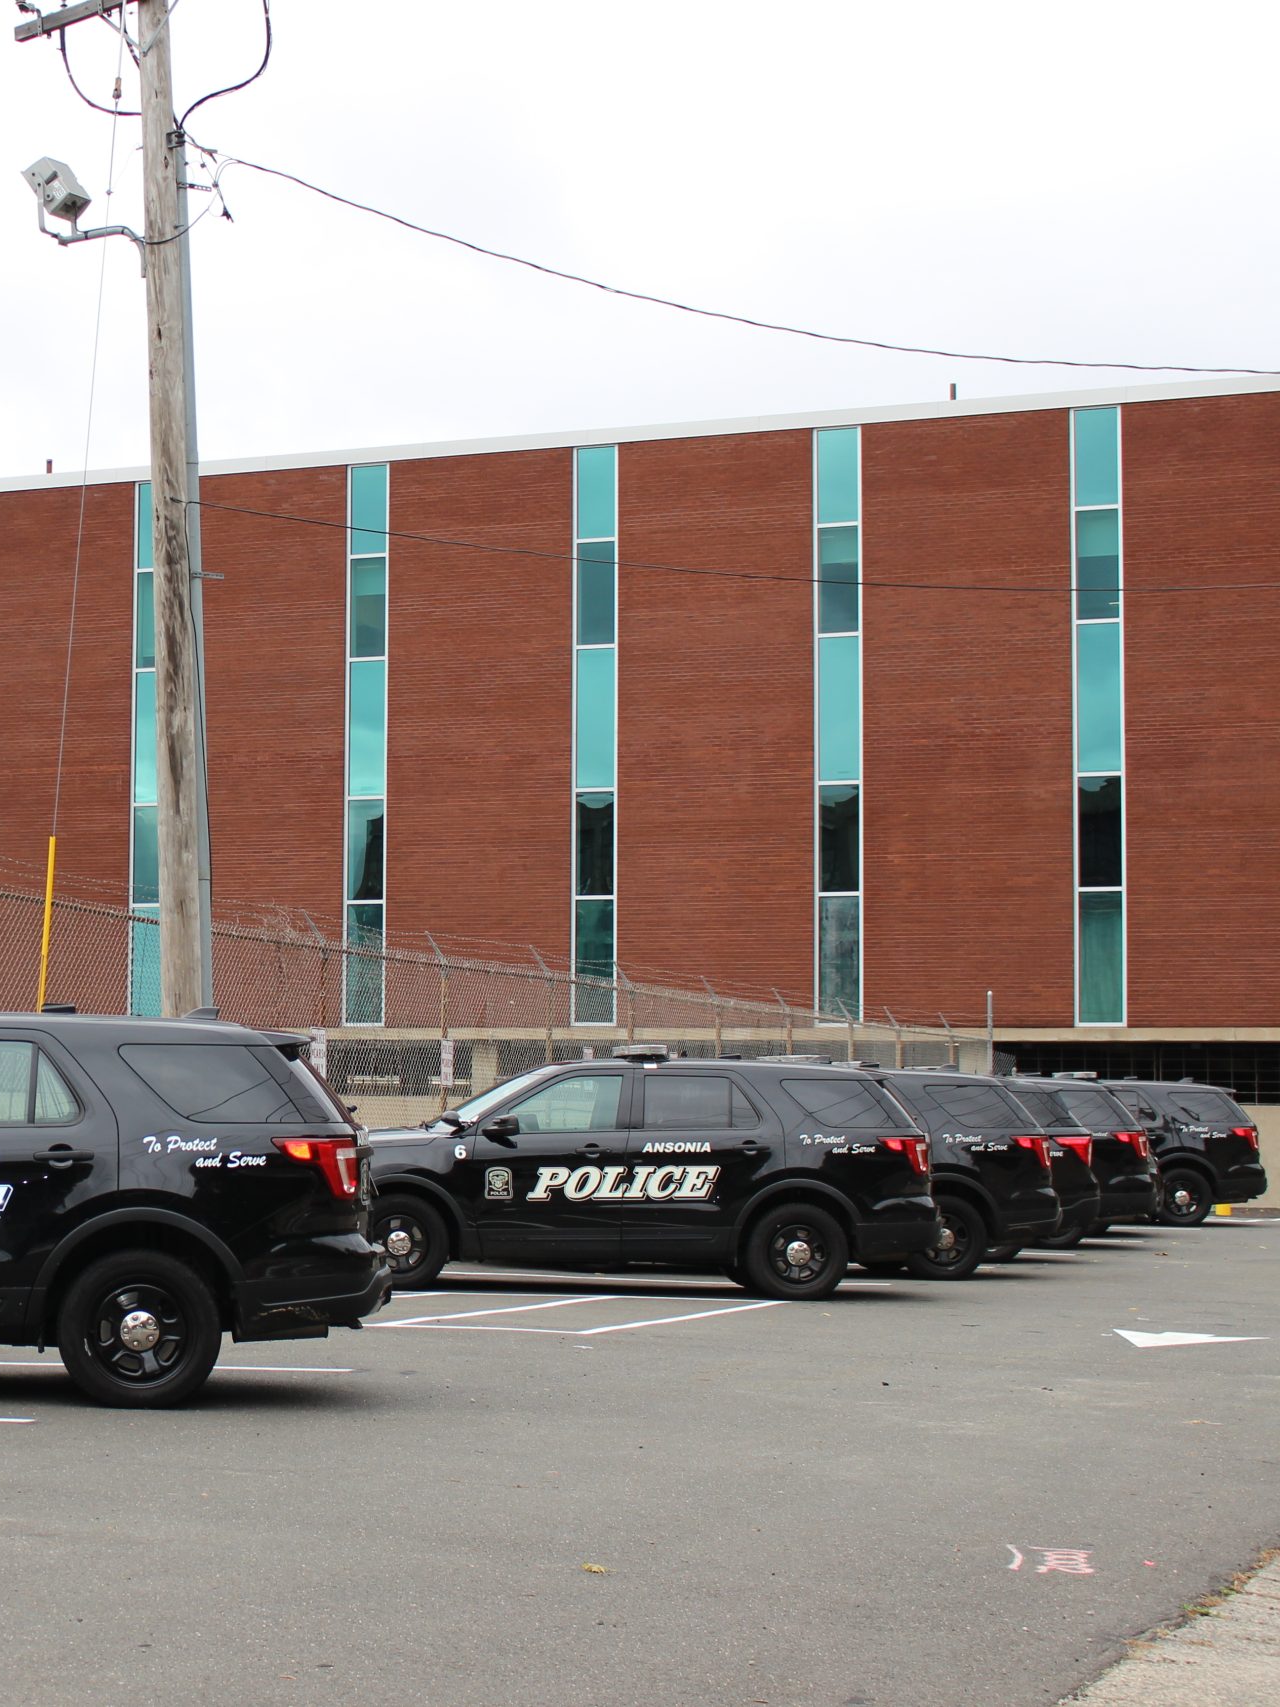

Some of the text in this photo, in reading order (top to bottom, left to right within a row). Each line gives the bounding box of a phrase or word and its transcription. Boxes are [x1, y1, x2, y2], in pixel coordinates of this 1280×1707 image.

[142, 1135, 218, 1154] To Protect
[799, 1134, 845, 1146] To Protect
[942, 1133, 982, 1144] To Protect
[454, 1144, 467, 1160] 6
[642, 1141, 712, 1153] ANSONIA
[832, 1143, 876, 1155] and Serve
[970, 1142, 1008, 1152] and Serve
[195, 1151, 267, 1168] and Serve
[525, 1164, 721, 1203] POLICE
